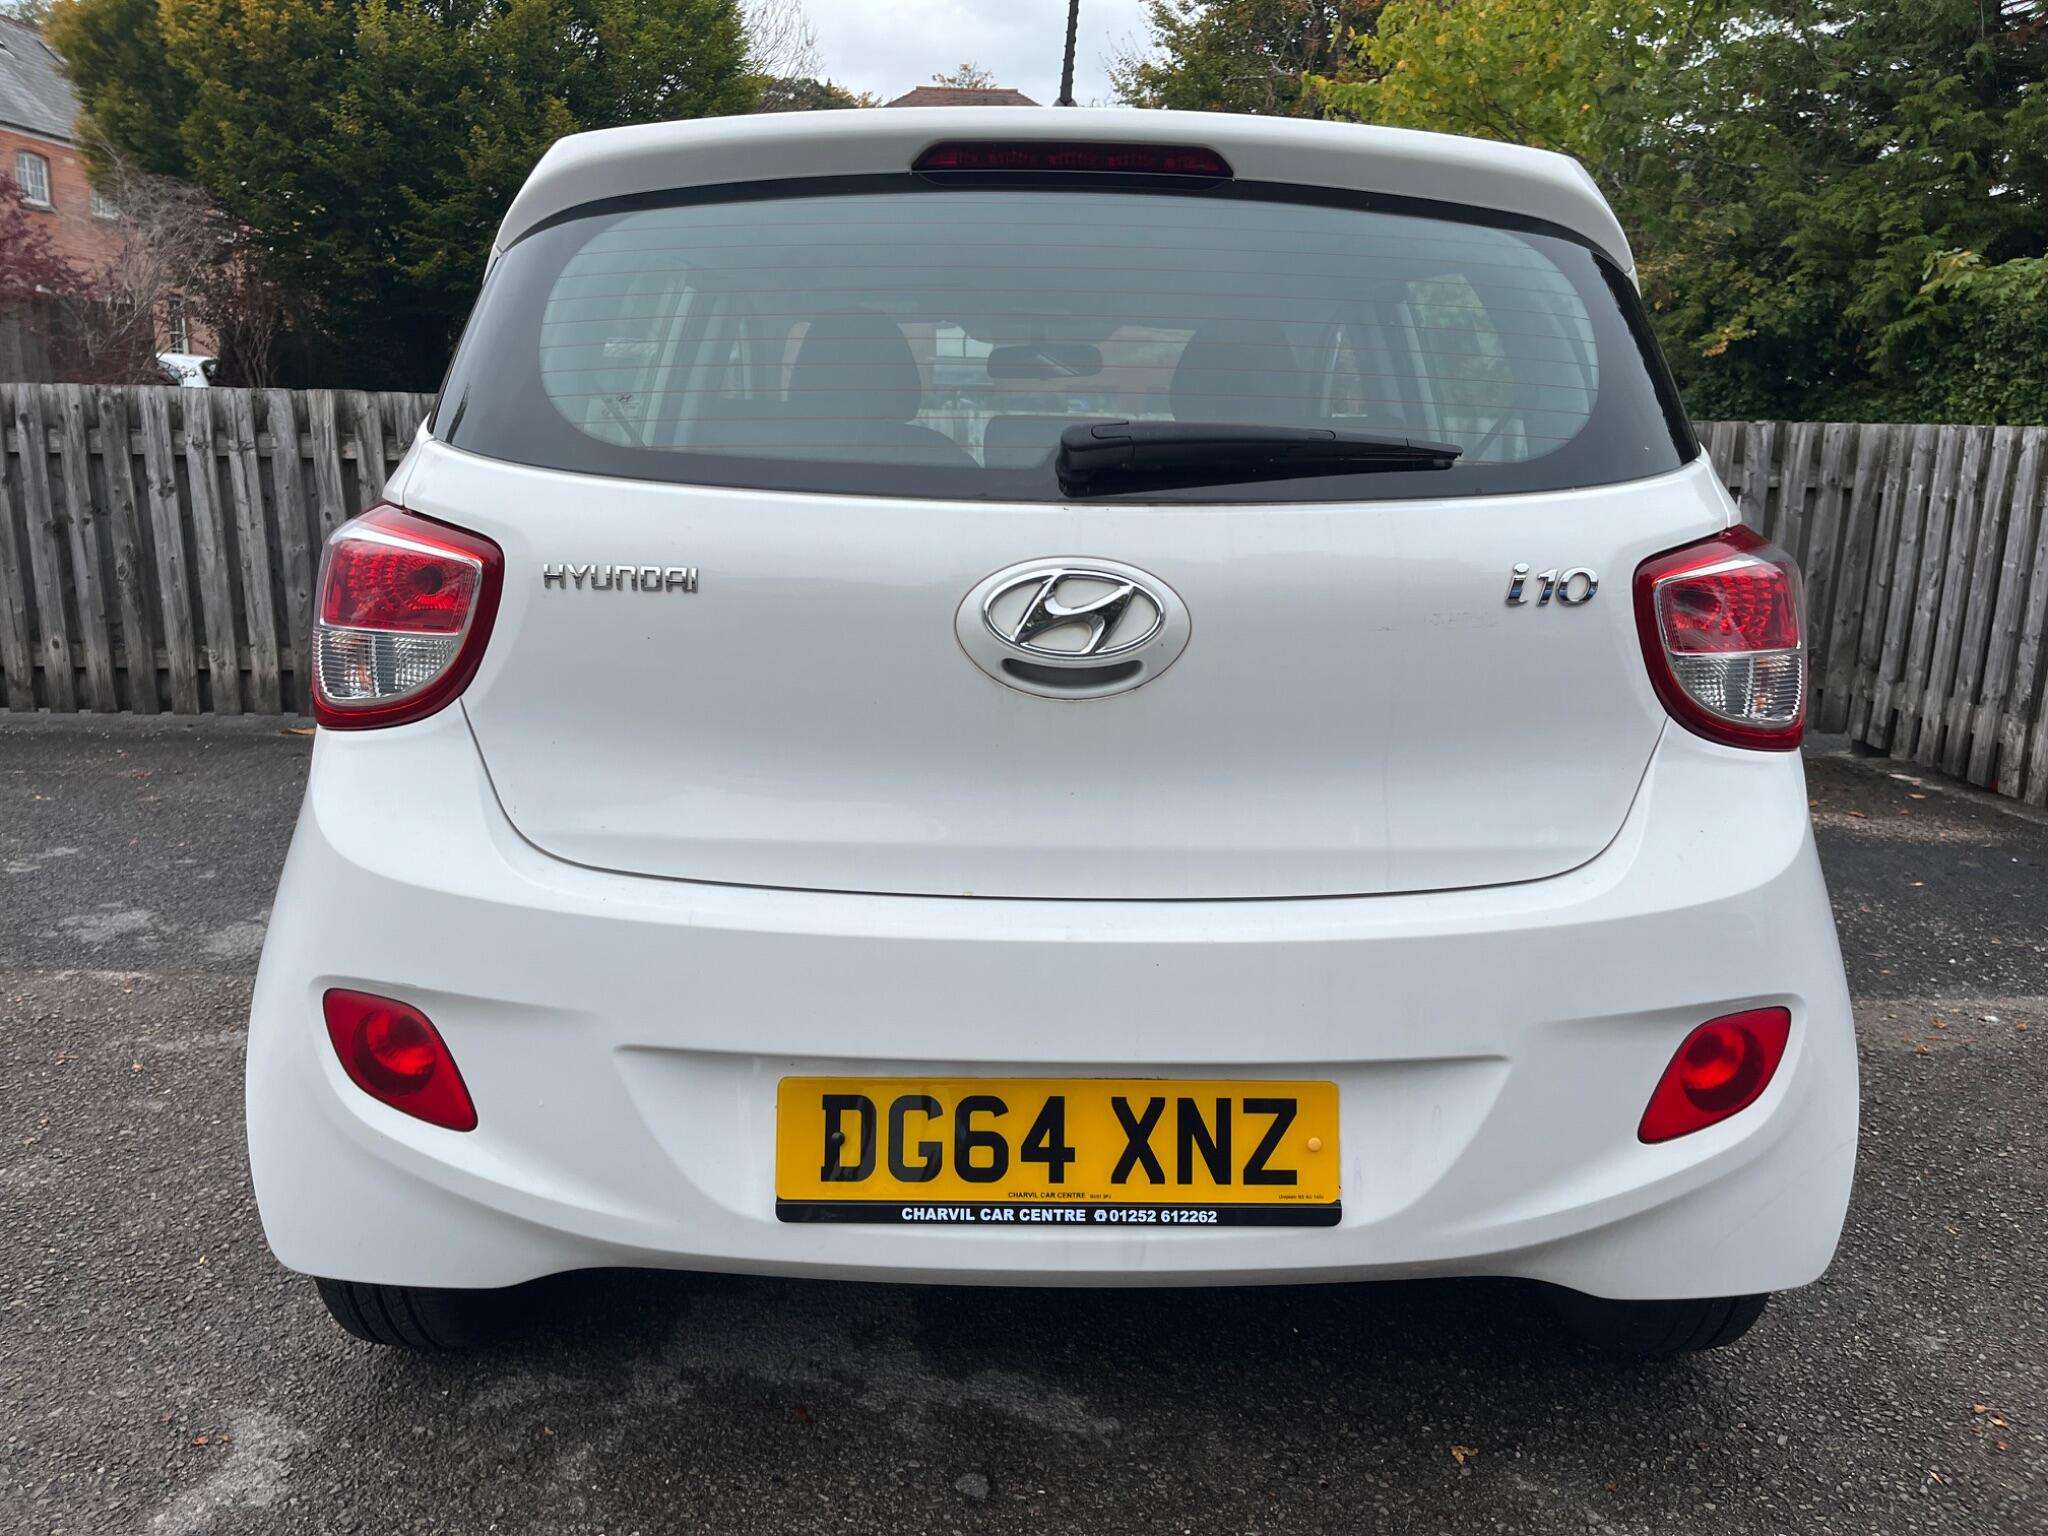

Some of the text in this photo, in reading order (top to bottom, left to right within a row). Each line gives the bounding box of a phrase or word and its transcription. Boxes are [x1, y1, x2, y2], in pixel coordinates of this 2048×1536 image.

[543, 563, 699, 594] HYUNDAI
[1504, 562, 1599, 608] i10
[820, 1094, 1298, 1185] DG64 XNZ
[1008, 1191, 1037, 1199] CHARVIL
[901, 1207, 1218, 1223] CHARVIL CAR CENTRE 01252 612262
